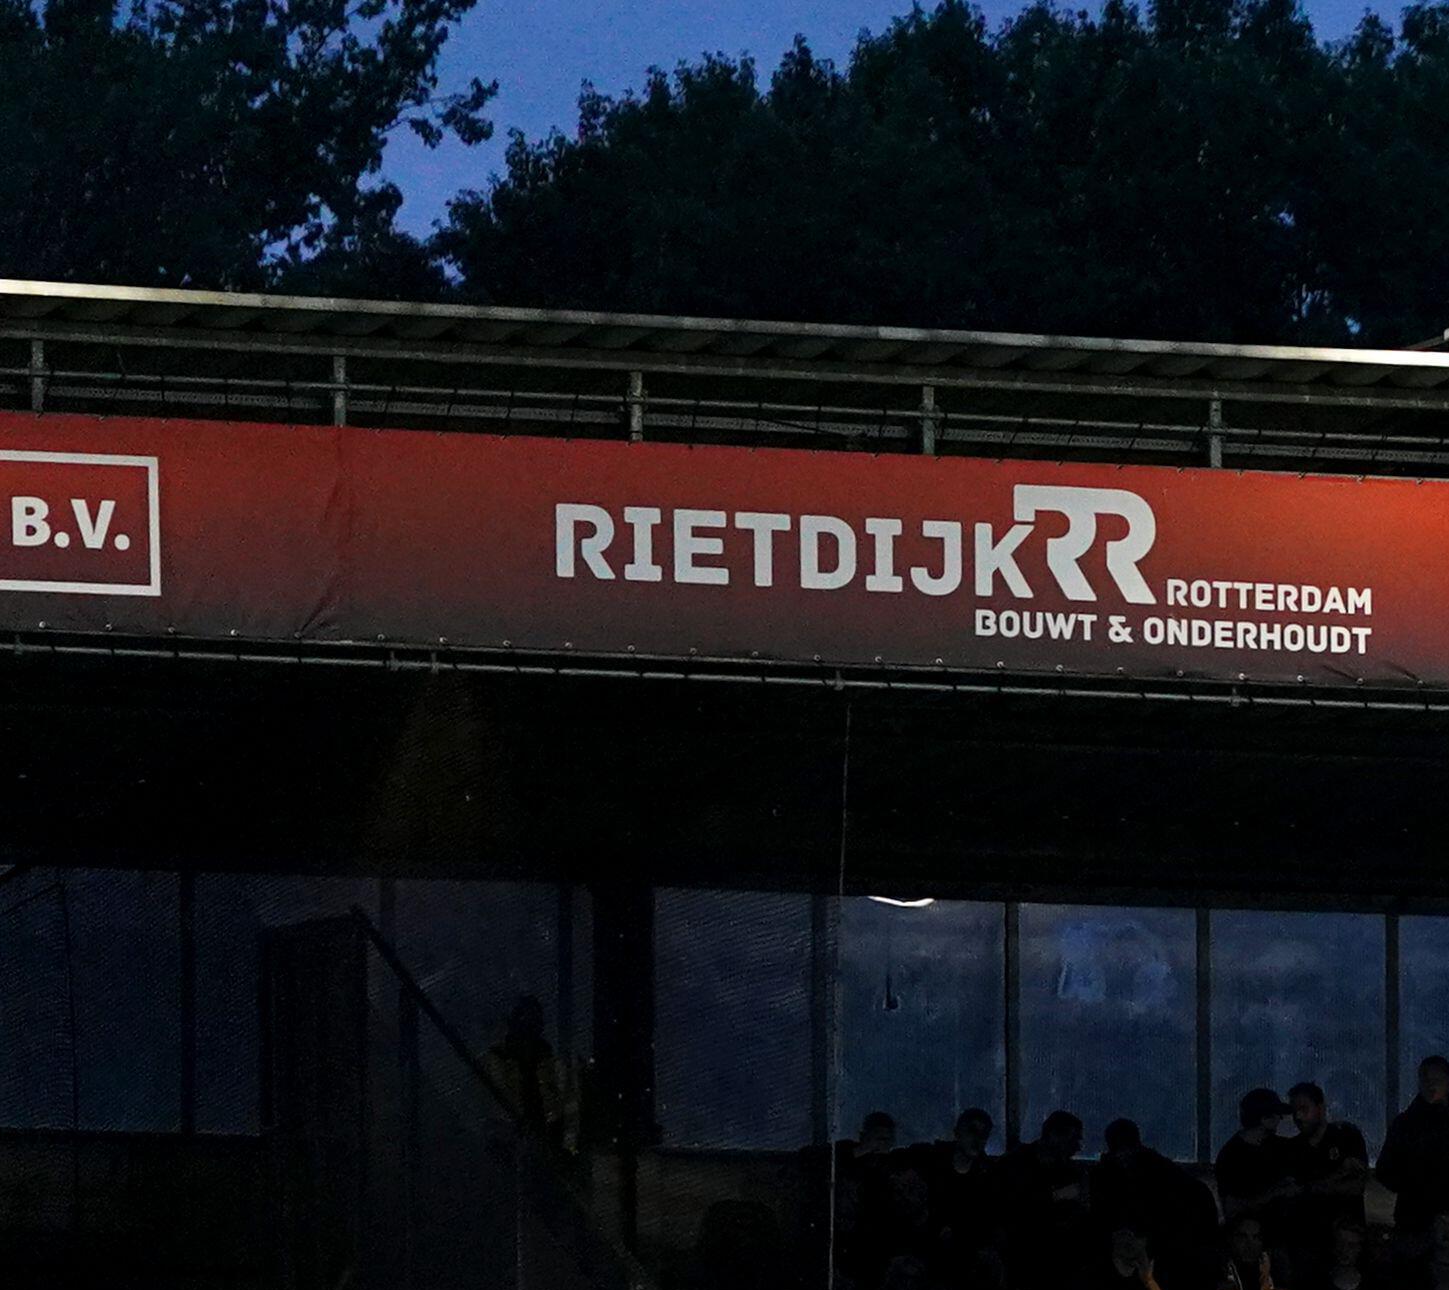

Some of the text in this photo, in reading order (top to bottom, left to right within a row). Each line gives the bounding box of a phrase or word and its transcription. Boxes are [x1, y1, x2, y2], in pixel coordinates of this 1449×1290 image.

[12, 494, 130, 553] B.V.
[556, 502, 1038, 602] RIETDIJK
[1166, 577, 1372, 617] ROTTERDAM
[975, 607, 1372, 656] BOUWT & ONDERHOUDT
